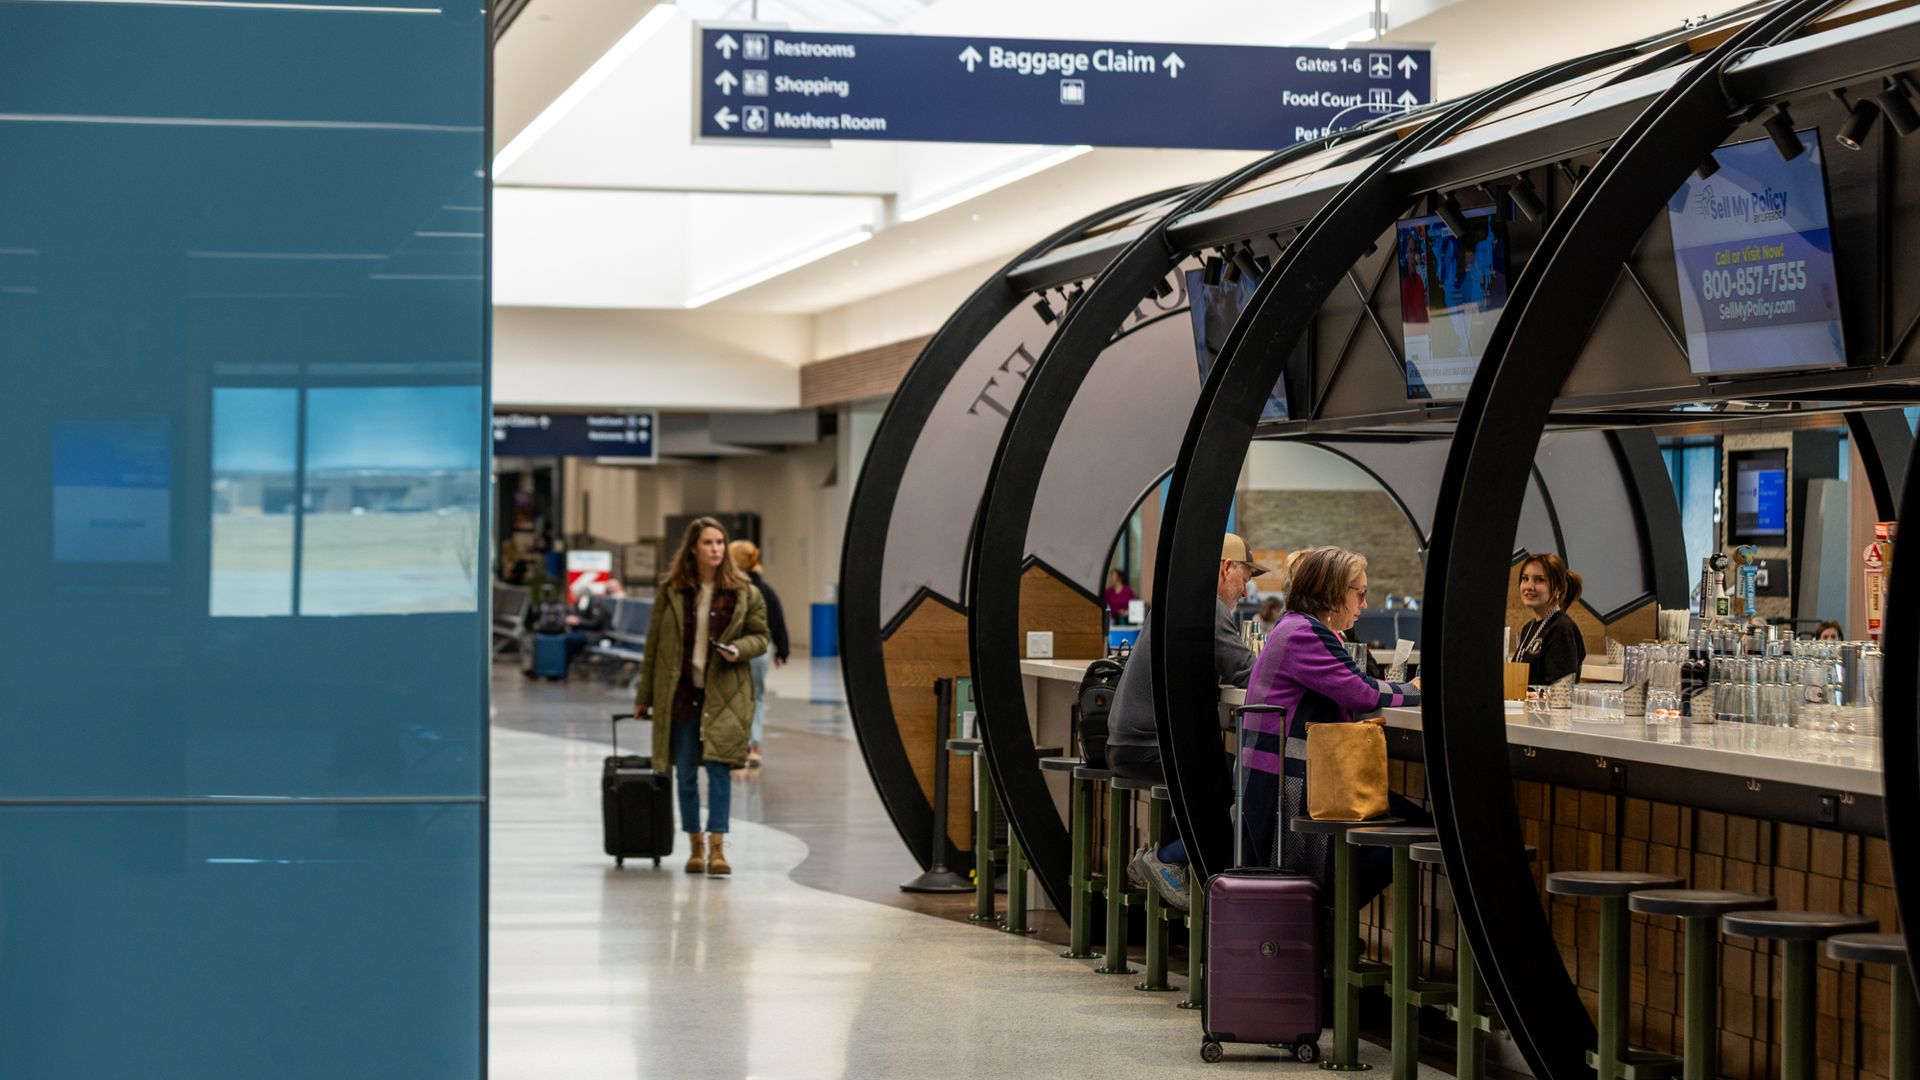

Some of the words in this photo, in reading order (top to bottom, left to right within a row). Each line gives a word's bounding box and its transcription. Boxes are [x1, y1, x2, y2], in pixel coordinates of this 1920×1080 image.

[774, 40, 855, 59] Restrooms
[989, 47, 1089, 76] Baggage
[1092, 49, 1155, 73] Claim
[1295, 56, 1337, 73] Gates
[1340, 57, 1362, 73] 1-6
[774, 77, 850, 97] Shopping
[1283, 91, 1319, 107] Food
[1321, 91, 1362, 108] Court
[774, 112, 840, 130] Mothers
[841, 114, 887, 131] Room
[1295, 126, 1319, 142] Pet
[1710, 197, 1730, 220] Sell
[1732, 195, 1749, 223] My
[1752, 187, 1787, 217] Policy
[1715, 251, 1730, 266] Call
[1732, 252, 1740, 265] or
[1742, 247, 1761, 262] Visit
[1702, 261, 1807, 300] 800-857-7355
[1719, 299, 1796, 321] SellMyPolicy.com
